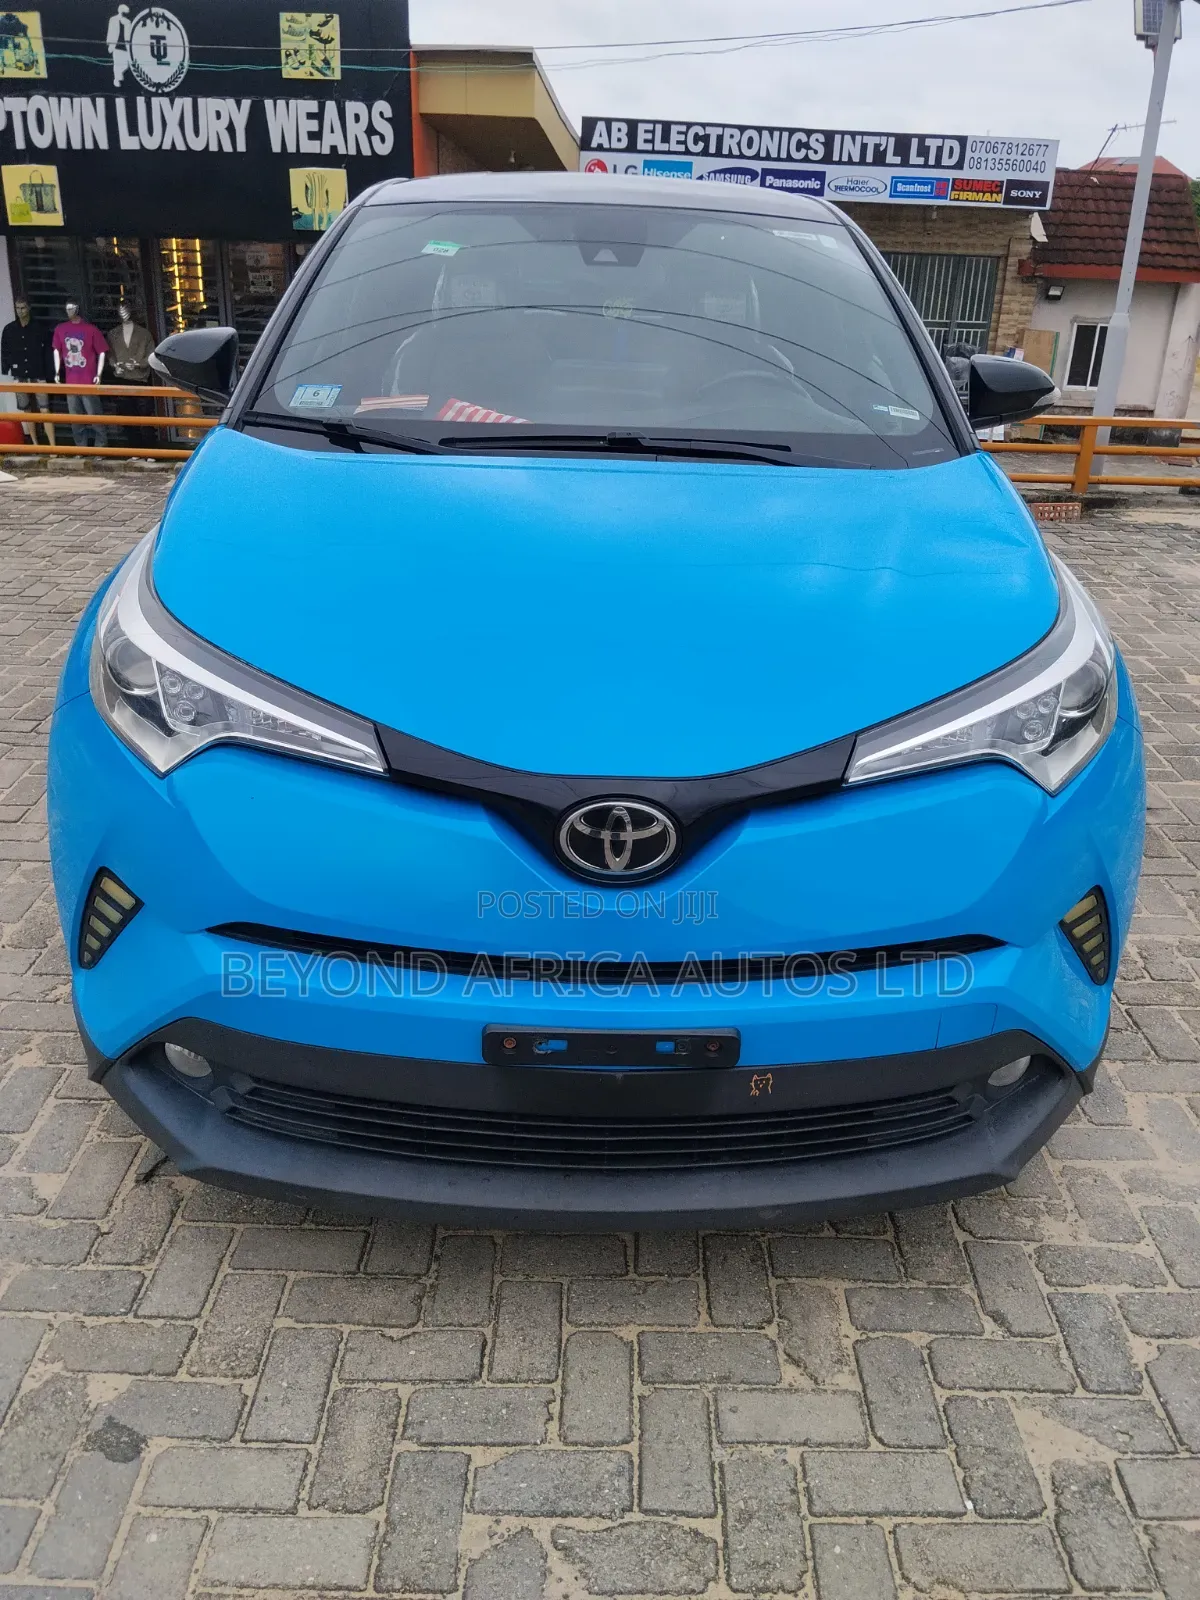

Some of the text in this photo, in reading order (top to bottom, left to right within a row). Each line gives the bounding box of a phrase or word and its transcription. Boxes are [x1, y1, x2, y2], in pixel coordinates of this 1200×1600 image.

[0, 94, 394, 156] TOWN LUXURY WEARS
[590, 121, 961, 168] AB ELECTRONICS INT'L LTD
[970, 140, 1049, 158] 07067812677
[968, 156, 1047, 174] 08135560040
[702, 172, 752, 185] SAMSUNG
[765, 175, 821, 189] Panasonic
[846, 177, 869, 186] Haier
[896, 182, 932, 193] Scanfrost
[953, 180, 1001, 192] SUMEC
[950, 191, 1002, 202] FIRMAN
[1010, 189, 1042, 199] SONY
